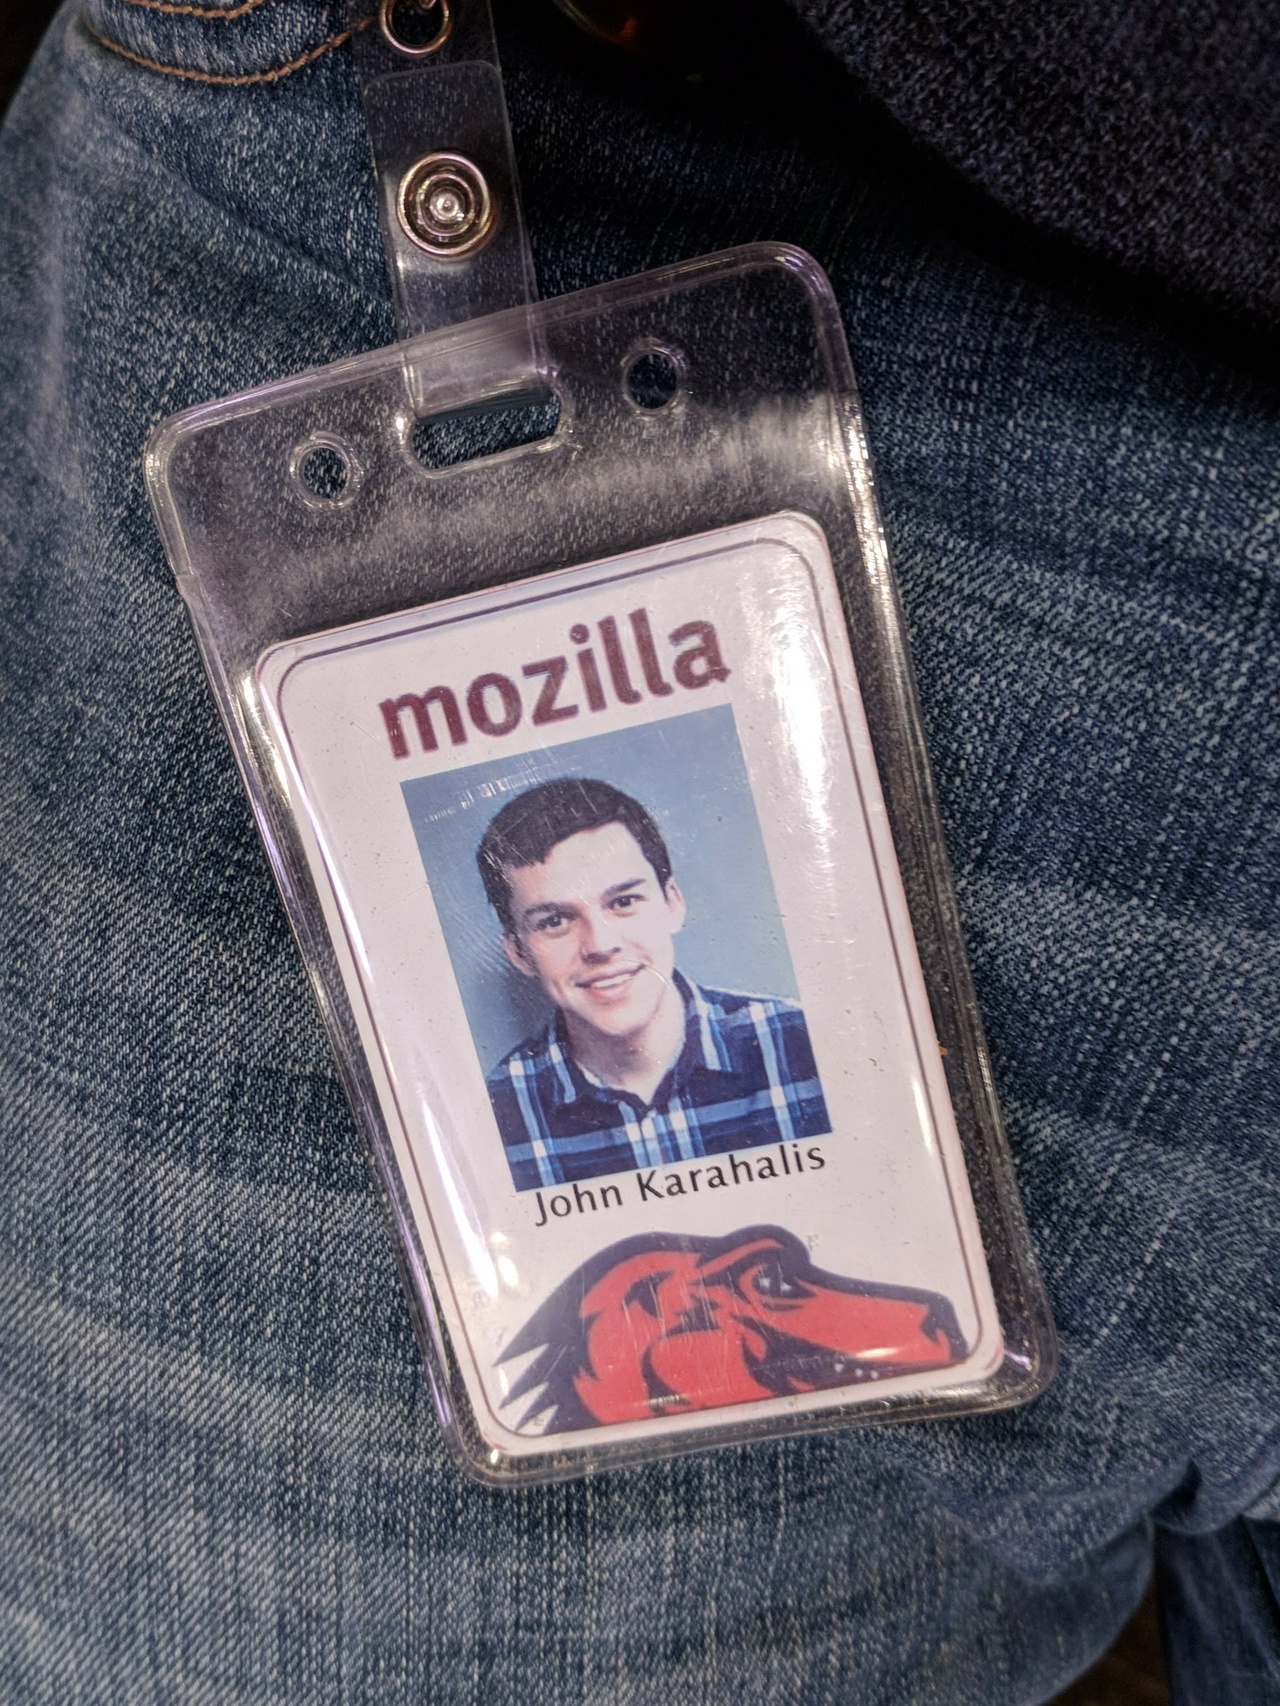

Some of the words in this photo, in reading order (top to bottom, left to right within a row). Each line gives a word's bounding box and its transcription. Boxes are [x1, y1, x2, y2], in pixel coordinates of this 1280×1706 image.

[378, 607, 732, 760] mozilla
[535, 1183, 623, 1227] John
[636, 1143, 826, 1202] Karahalis
